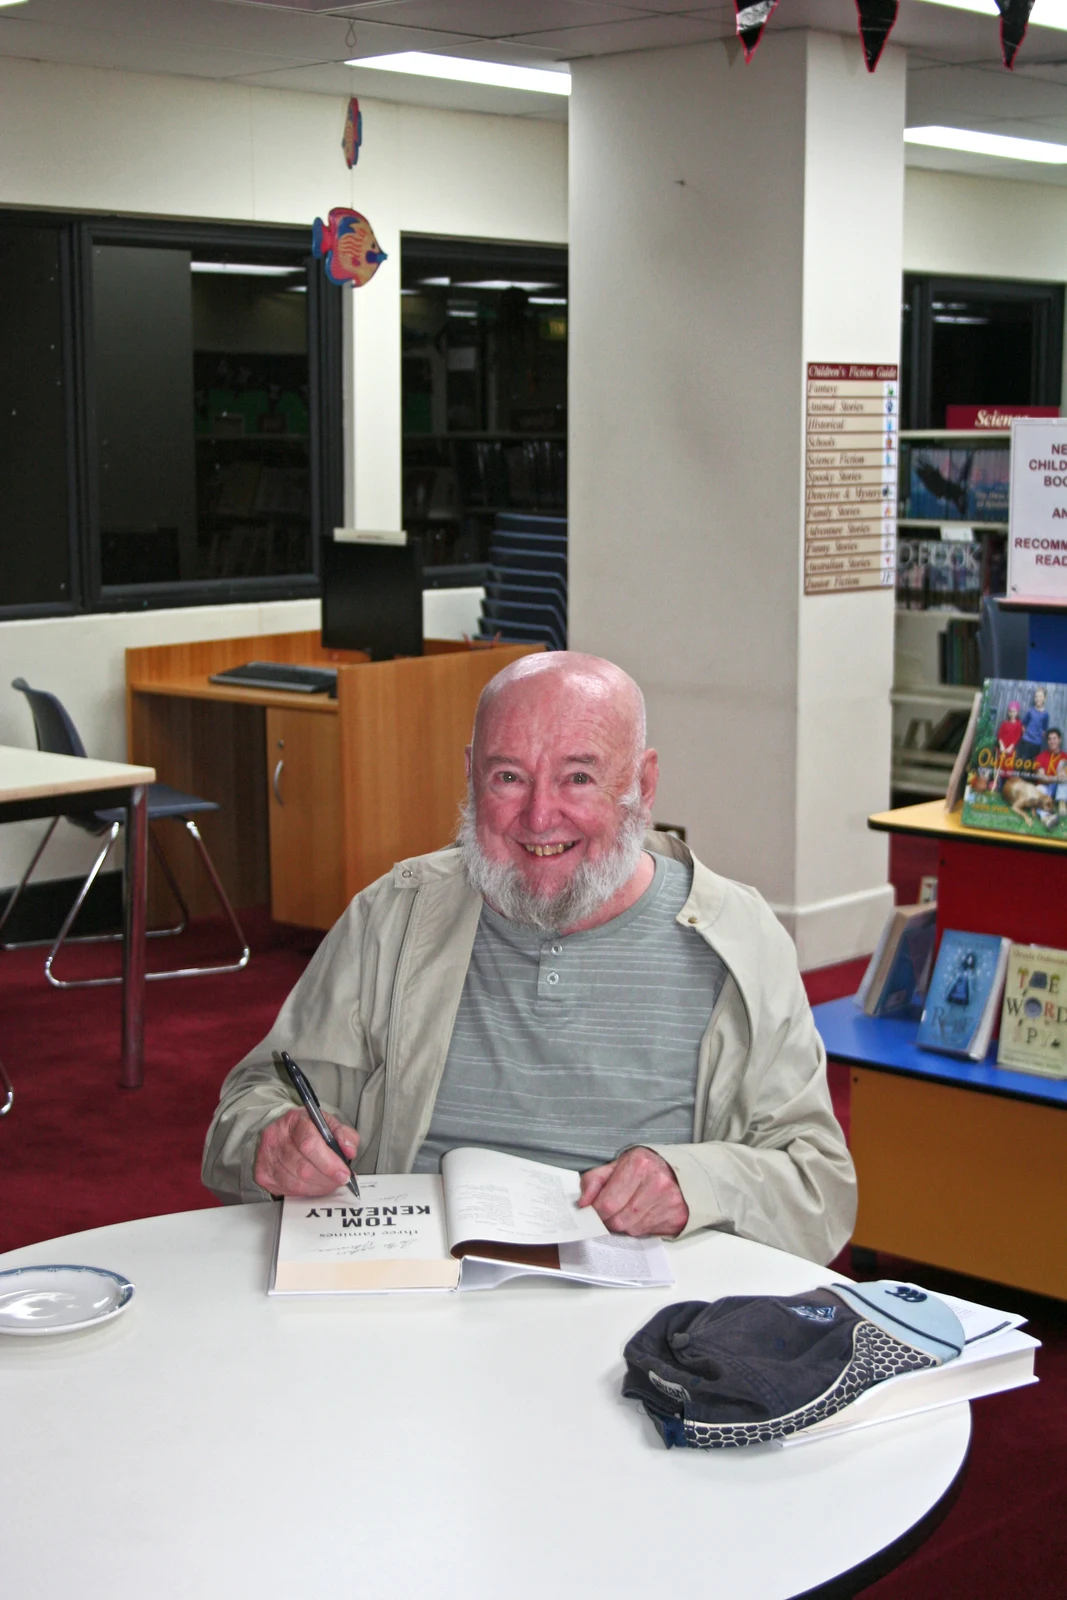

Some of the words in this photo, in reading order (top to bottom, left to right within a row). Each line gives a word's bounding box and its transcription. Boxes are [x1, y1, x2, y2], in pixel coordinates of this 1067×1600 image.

[808, 364, 846, 377] Children's
[848, 366, 874, 378] Fiction
[876, 366, 896, 378] Guide
[807, 381, 838, 397] Fantasy
[808, 399, 836, 411] Animal
[839, 400, 864, 411] Stories
[807, 417, 844, 430] Historical
[975, 408, 1029, 428] Scien
[807, 436, 836, 448] Schools
[807, 453, 835, 466] Science
[838, 452, 865, 464] Fiction
[806, 473, 833, 486] Spooky
[837, 471, 863, 482] Stories
[807, 487, 841, 500] Detective
[842, 488, 850, 499] &
[854, 486, 881, 501] Mystery
[806, 504, 833, 520] Family
[837, 504, 861, 516] Stories
[847, 523, 871, 534] Stories
[806, 542, 831, 556] Funny
[835, 540, 858, 552] Stories
[847, 556, 871, 568] Stories
[806, 576, 830, 589] Junior
[834, 574, 860, 587] Fiction
[978, 748, 1040, 769] Outdoor
[305, 1205, 431, 1219] KENEALLY
[342, 1216, 396, 1228] TOM
[319, 1230, 375, 1238] famines
[381, 1229, 418, 1237] three
